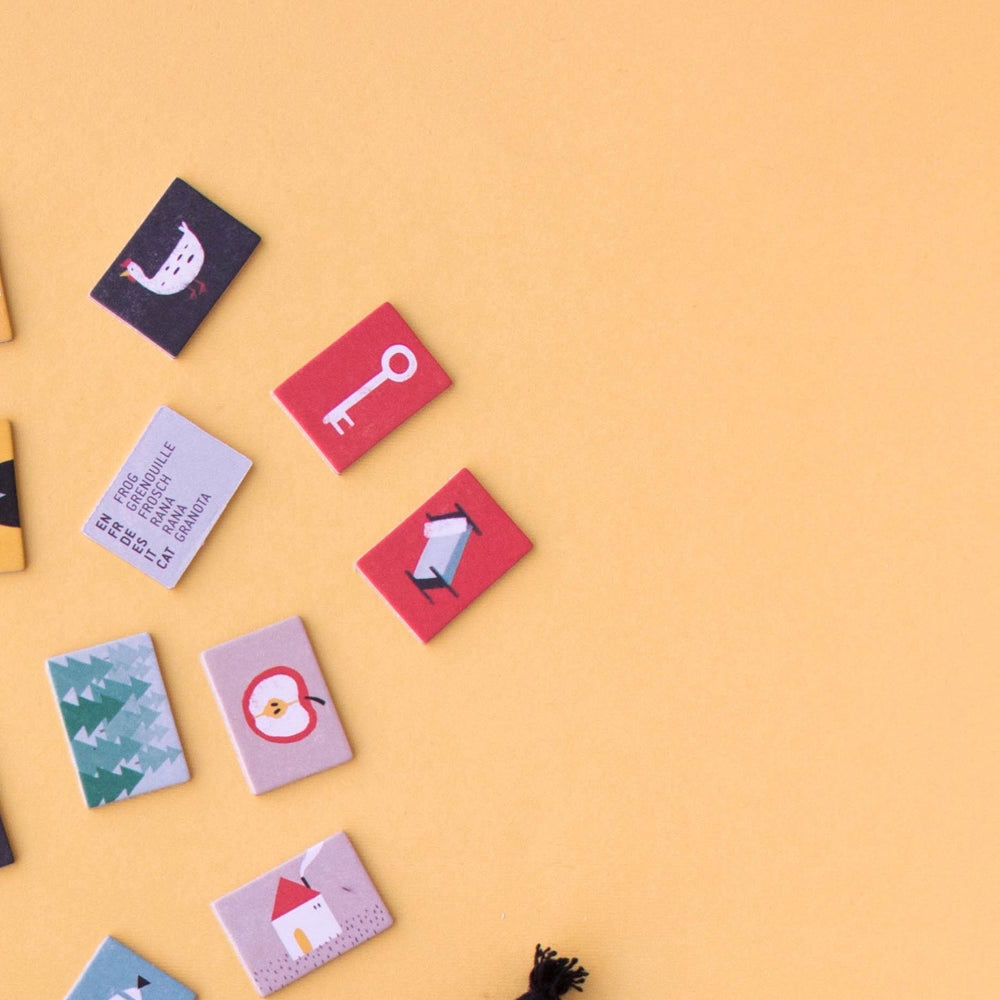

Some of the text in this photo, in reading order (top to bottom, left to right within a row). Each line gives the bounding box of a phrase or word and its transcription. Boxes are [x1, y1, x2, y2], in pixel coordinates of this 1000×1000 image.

[95, 472, 139, 531] EN FROG
[108, 441, 176, 539] FR GRENOUILLE
[120, 474, 172, 546] DE FROSCH
[132, 496, 175, 554] ES RANA
[144, 504, 188, 562] IT RANA
[156, 493, 212, 569] CAT GRANOTA
